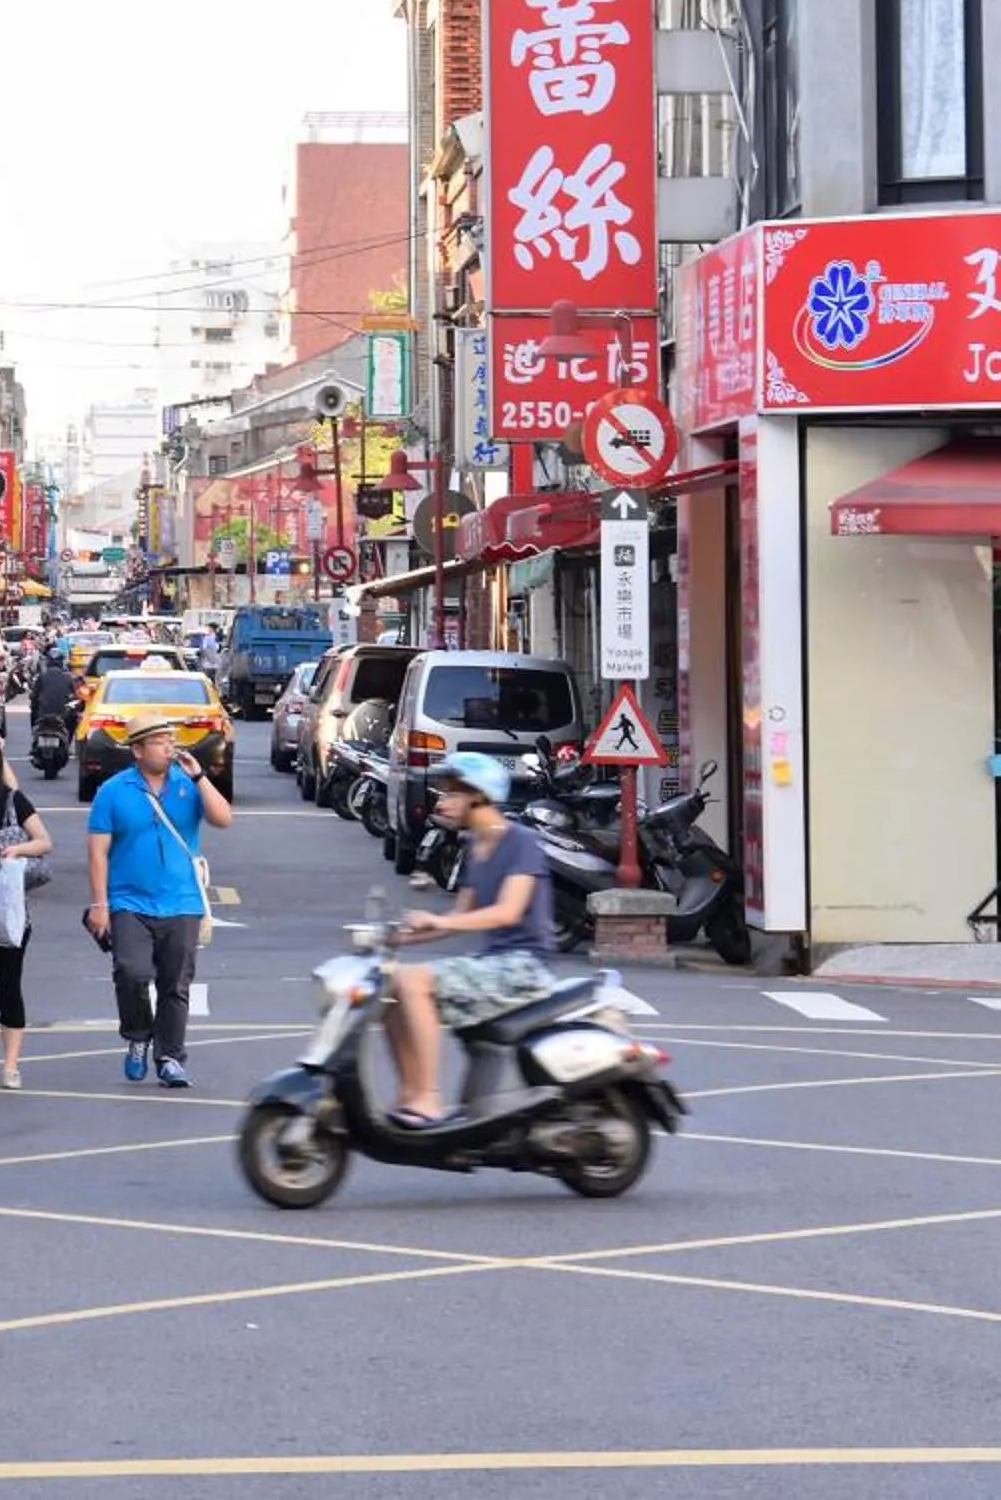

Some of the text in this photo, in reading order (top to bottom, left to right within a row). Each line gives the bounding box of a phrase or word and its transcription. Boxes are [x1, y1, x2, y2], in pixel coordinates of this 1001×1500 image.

[501, 401, 597, 429] 2550-
[617, 571, 632, 640] 永樂市場
[607, 662, 642, 673] Market
